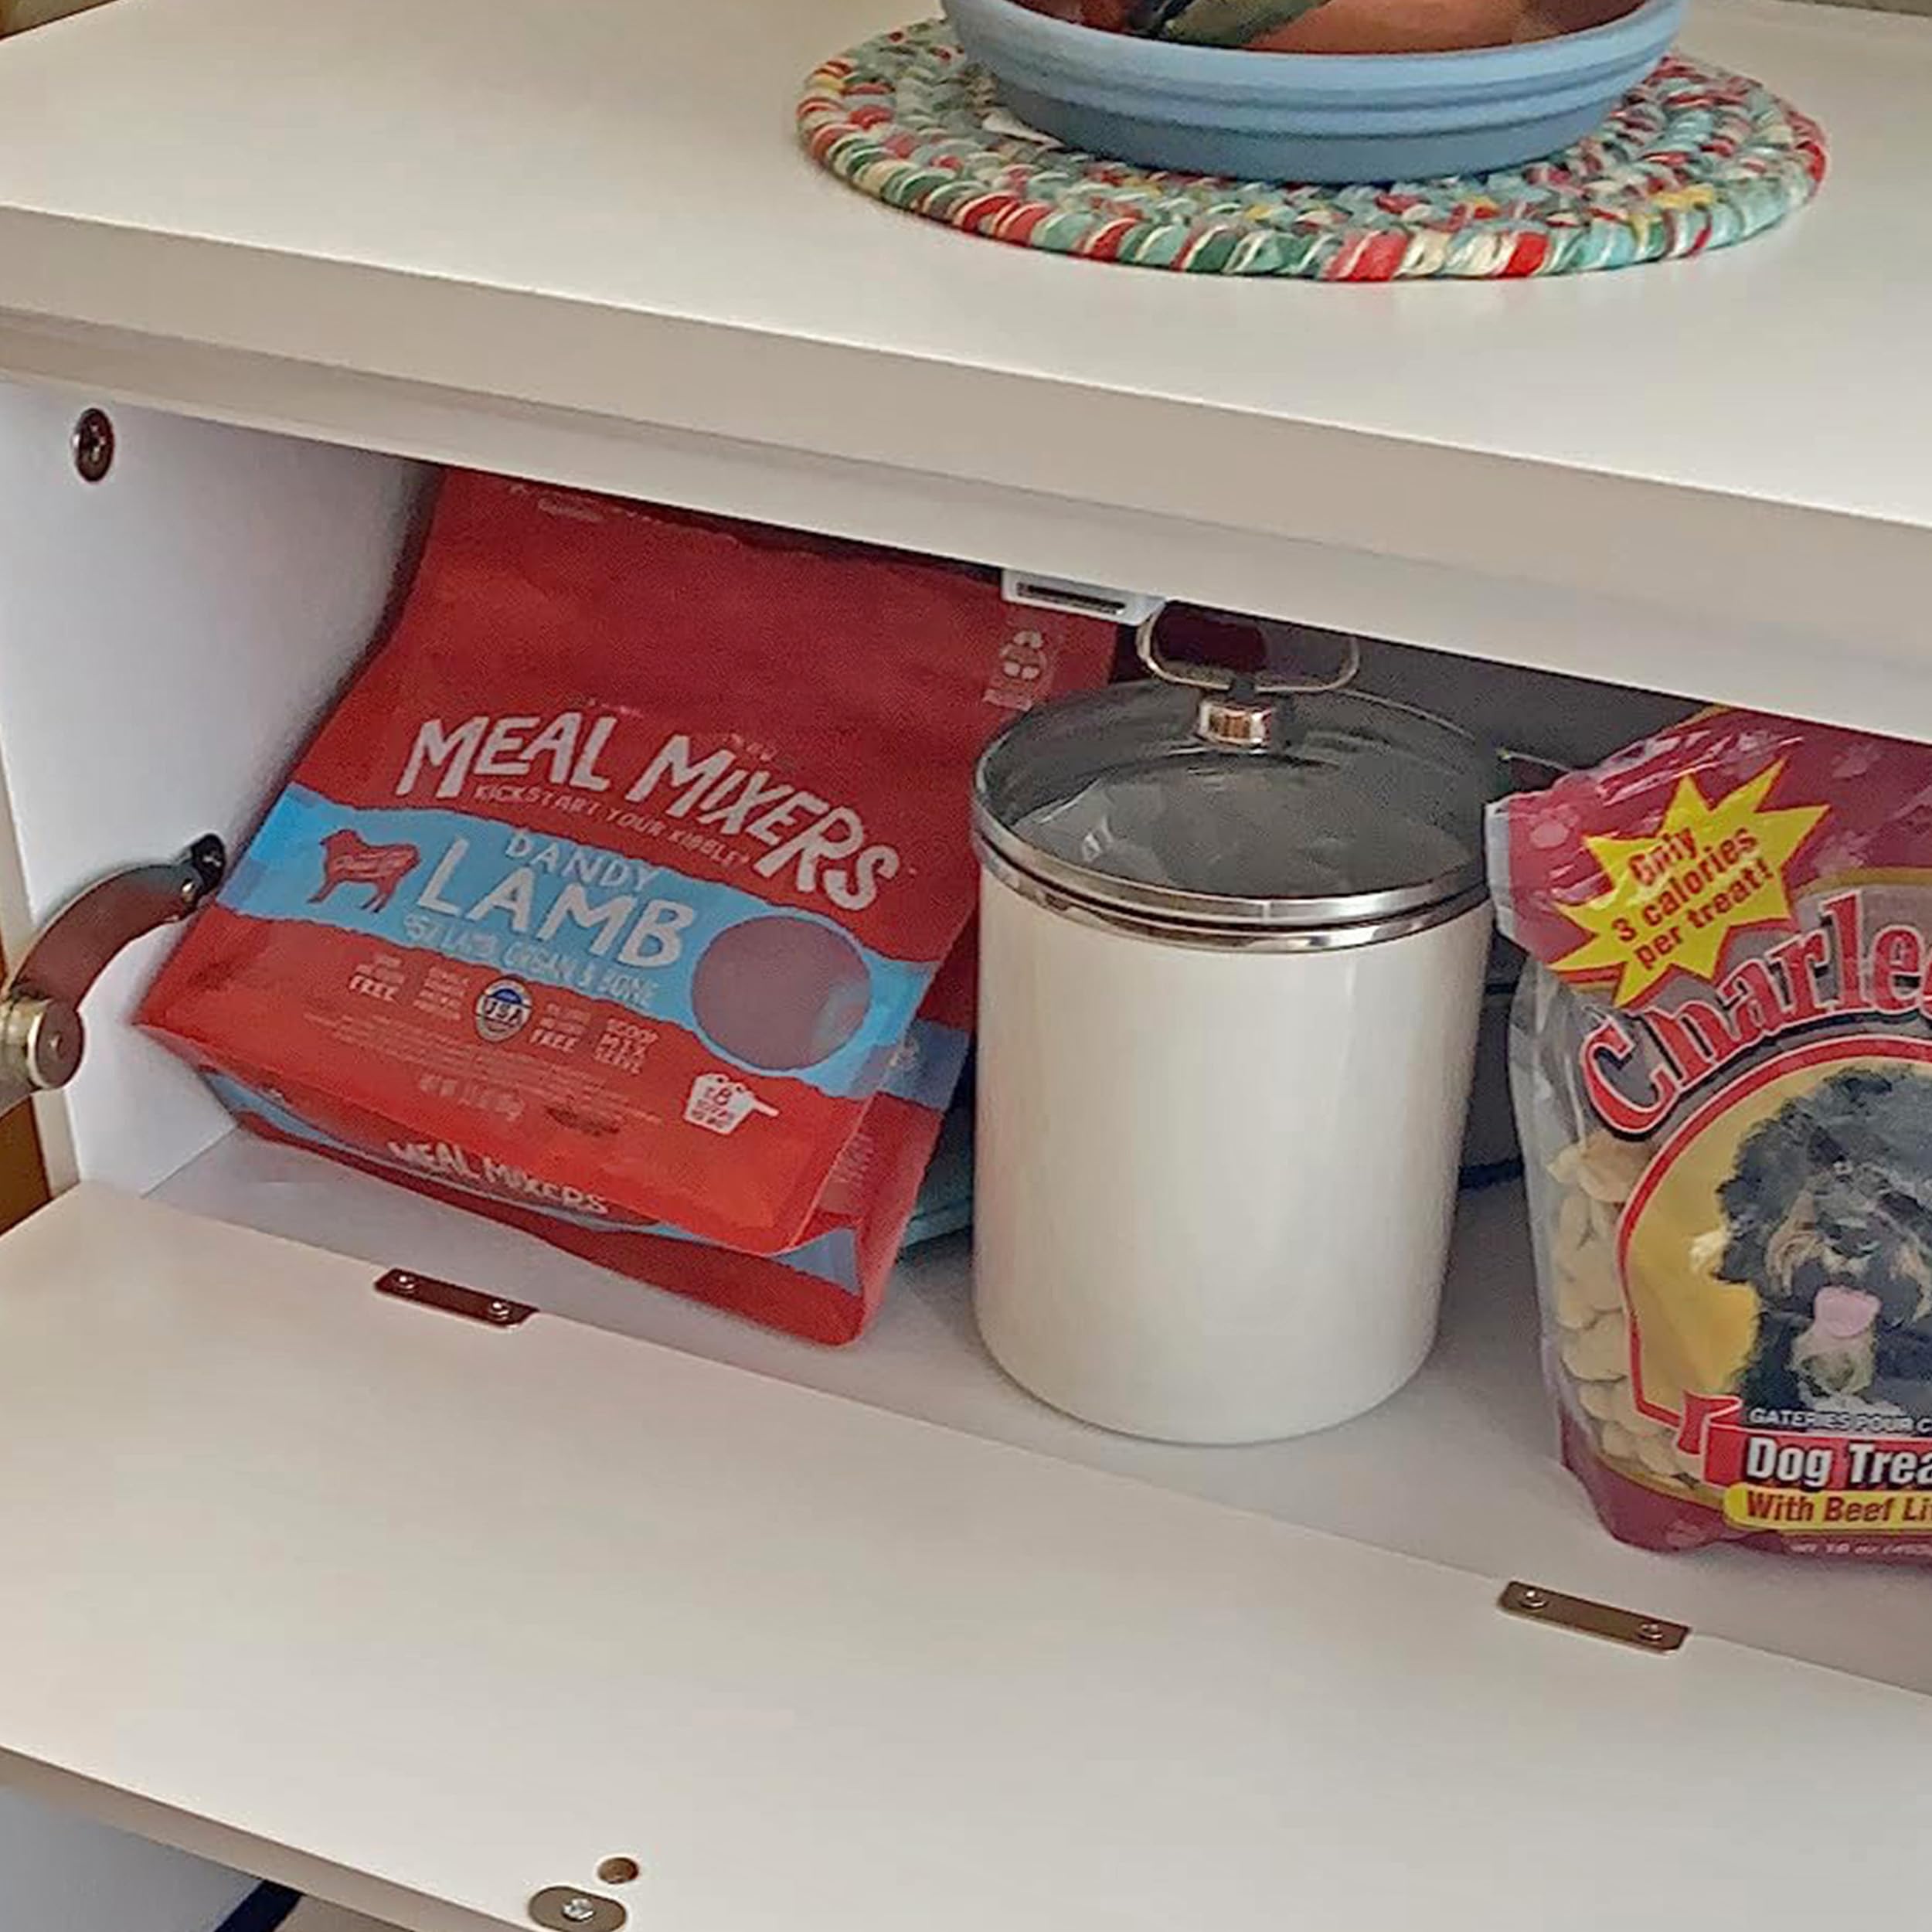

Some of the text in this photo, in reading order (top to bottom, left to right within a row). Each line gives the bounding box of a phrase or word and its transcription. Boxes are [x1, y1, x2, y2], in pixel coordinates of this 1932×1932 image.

[395, 712, 900, 911] MEAL MIXERS
[473, 784, 601, 816] KICKSTART
[605, 809, 667, 837] YOUR
[505, 830, 659, 890] DANDY
[1611, 827, 1758, 942] 3 calories
[417, 837, 696, 966] LAMB
[1634, 858, 1774, 971] per treat!
[483, 1000, 523, 1029] USA
[1580, 891, 1932, 1138] Charle
[387, 1141, 609, 1214] MEAL MIXERS
[1855, 1413, 1915, 1432] POUR
[1746, 1436, 1932, 1488] Dog Trea
[1747, 1490, 1932, 1522] With Beef Li
